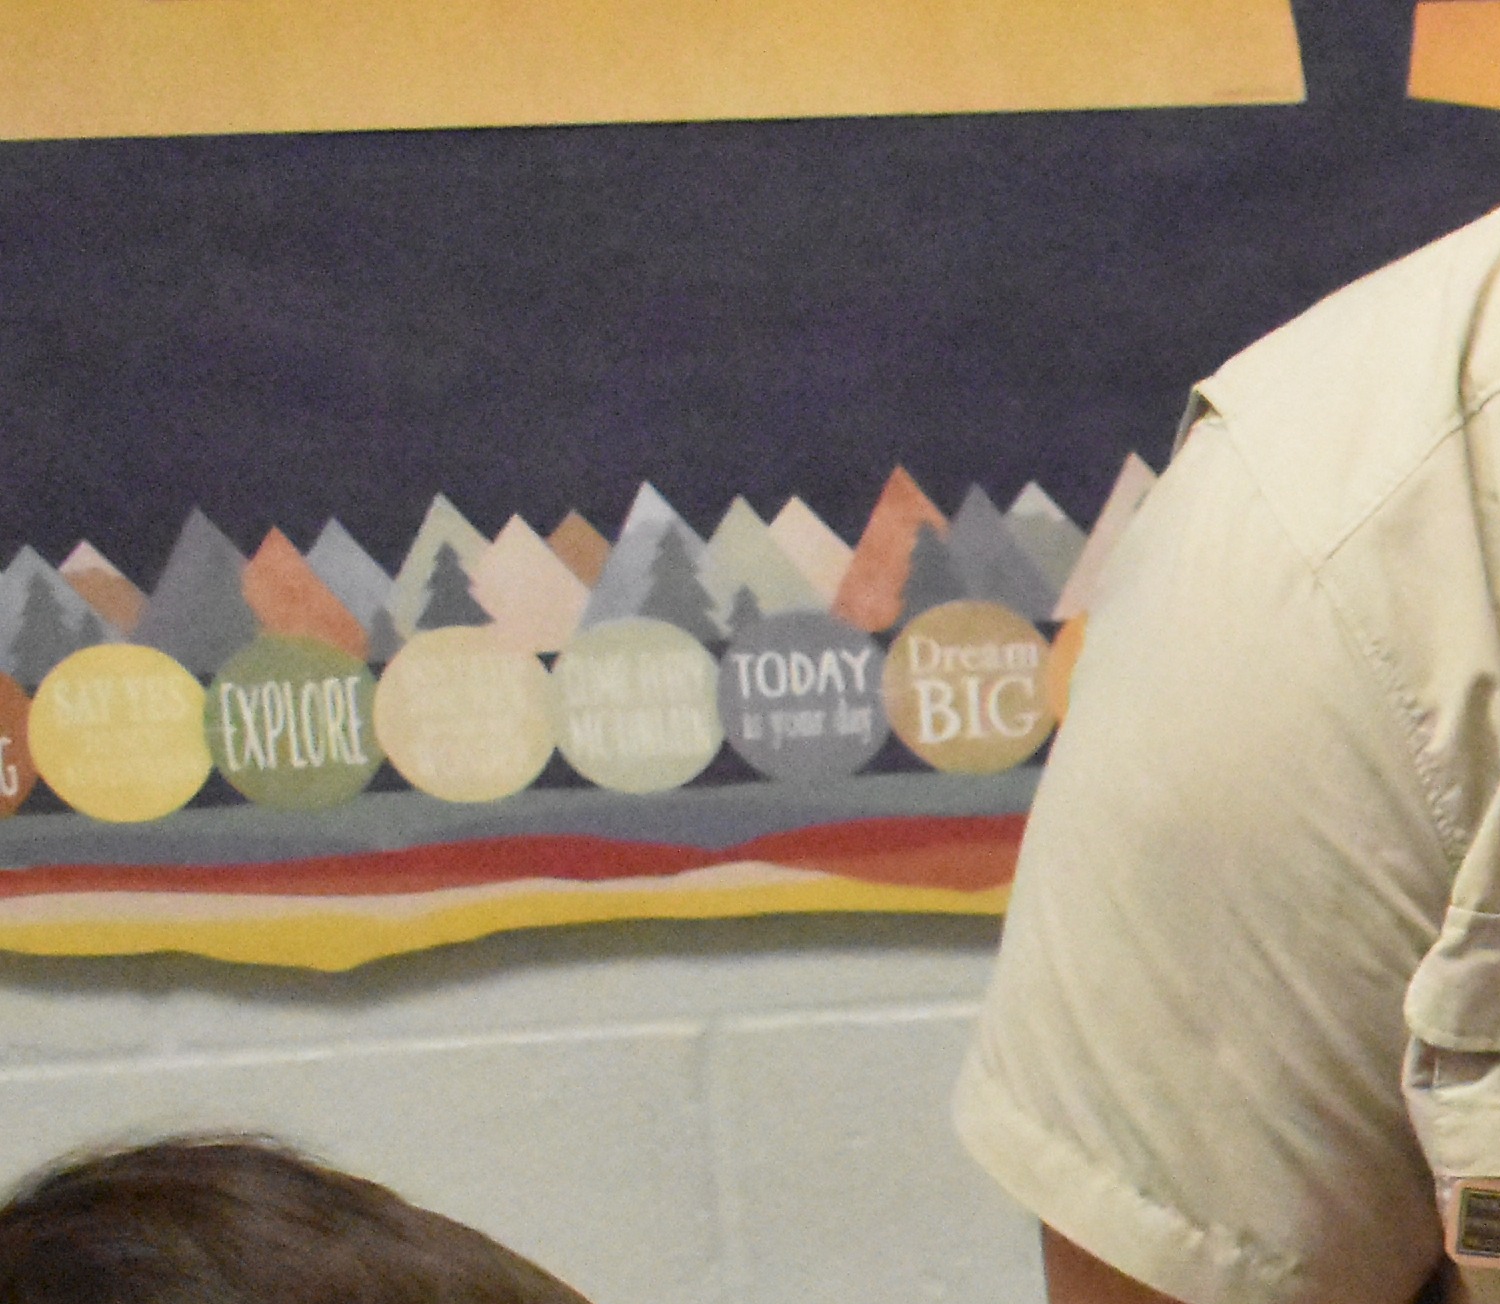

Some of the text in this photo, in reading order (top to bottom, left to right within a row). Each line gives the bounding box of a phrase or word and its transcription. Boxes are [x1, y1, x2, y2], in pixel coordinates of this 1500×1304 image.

[732, 648, 872, 699] TODAY
[908, 634, 1039, 674] Dream
[219, 675, 368, 773] EXPLORE
[910, 674, 1038, 745] BIG
